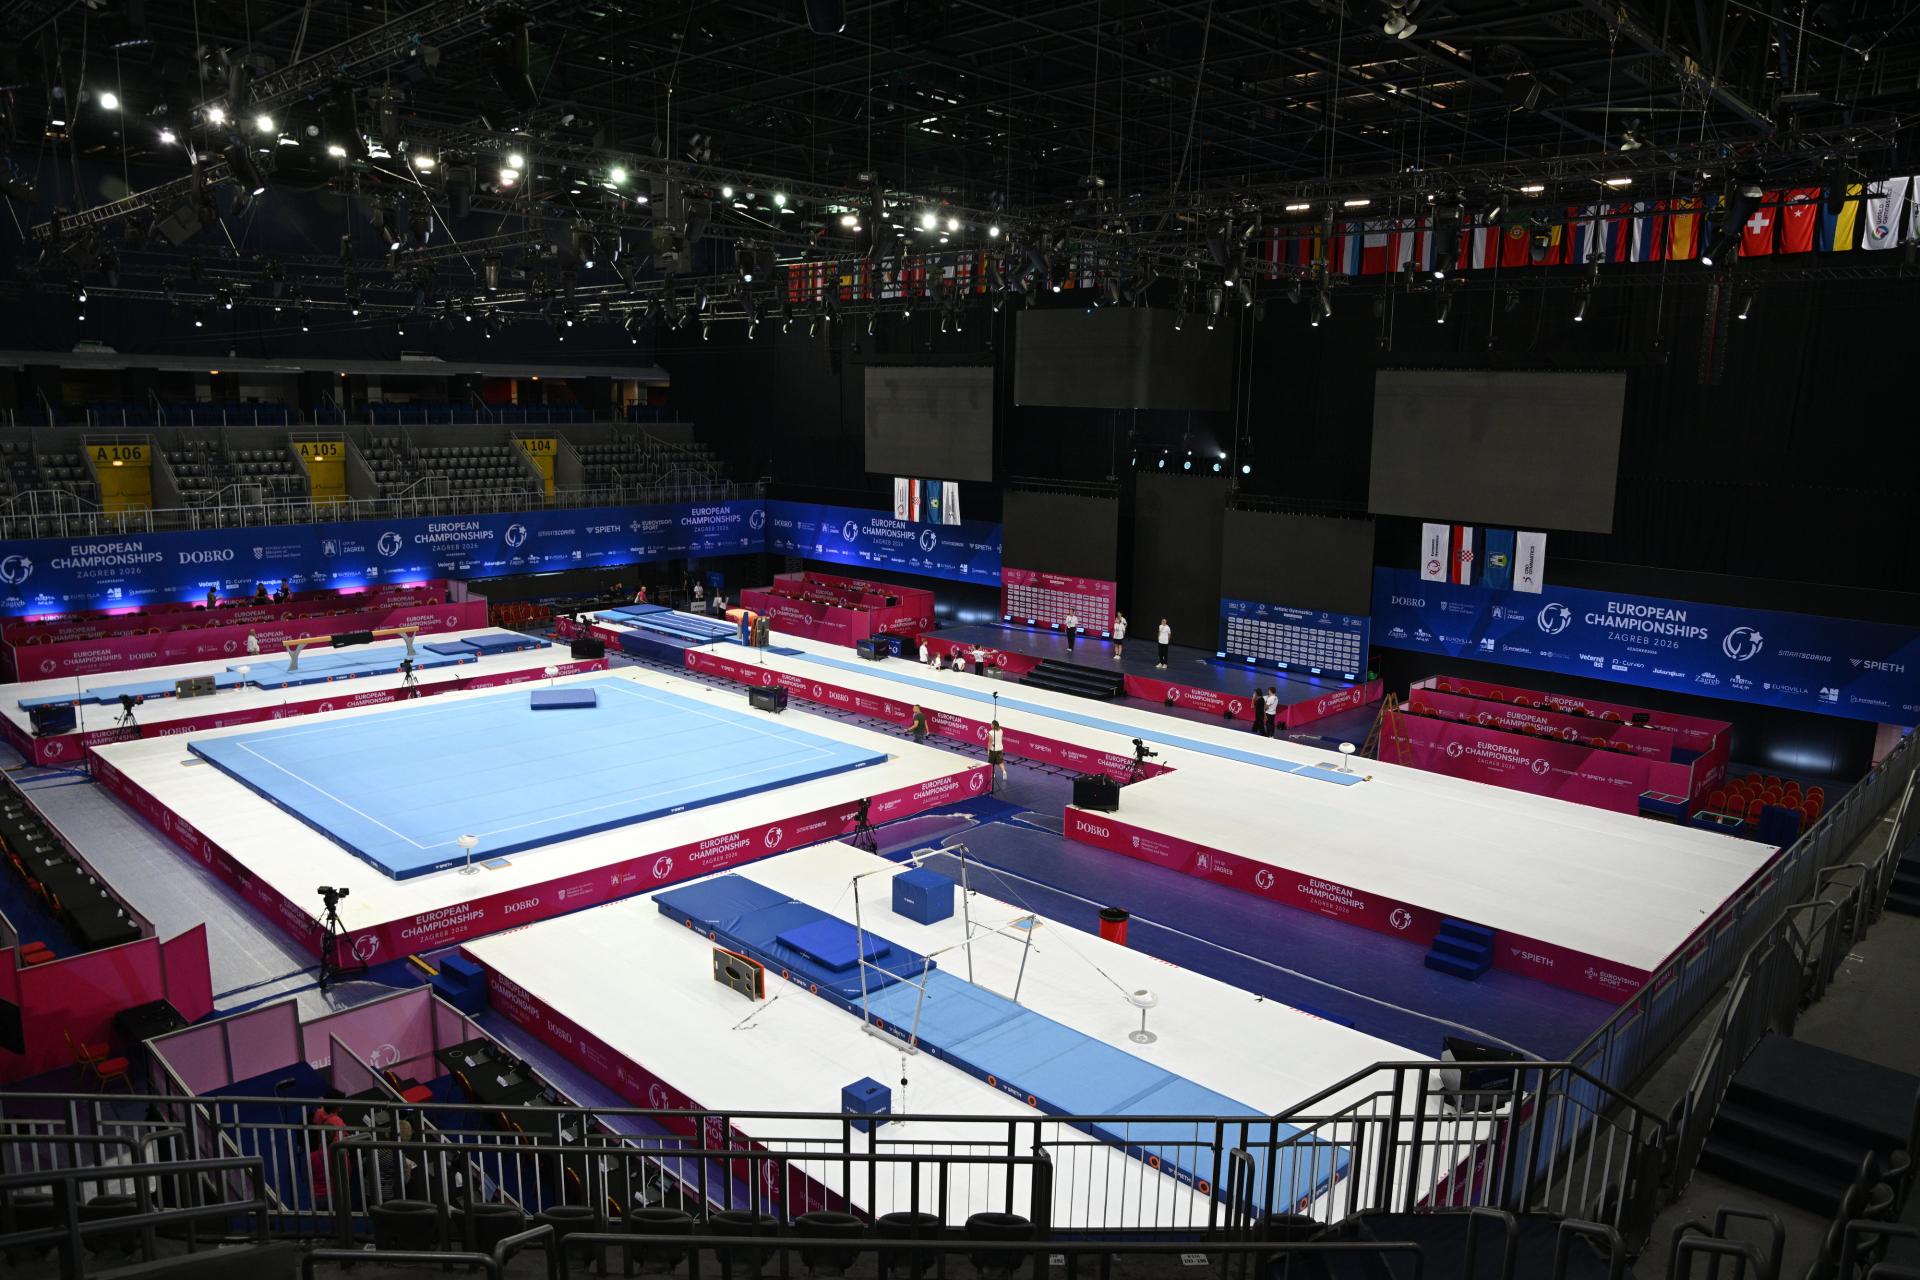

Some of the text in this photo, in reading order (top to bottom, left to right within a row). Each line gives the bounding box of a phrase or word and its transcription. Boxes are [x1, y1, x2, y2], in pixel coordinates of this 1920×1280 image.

[301, 444, 336, 456] A 105
[531, 441, 550, 451] 104
[97, 447, 141, 460] A 106
[691, 507, 730, 516] EUROPEAN
[429, 522, 479, 532] EUROPEAN
[681, 515, 741, 526] CHAMPIONSHIPS
[871, 519, 905, 529] EUROPEAN
[415, 530, 494, 544] CHAMPIONSHIPS
[595, 526, 620, 534] SPIETH
[862, 527, 915, 540] CHAMPIONSHIPS
[71, 542, 142, 556] EUROPEAN
[51, 552, 163, 569] CHAMPIONSHIPS
[179, 549, 234, 564] DOBRO
[119, 567, 141, 576] 2026
[1392, 596, 1425, 607] DOBRO
[1608, 602, 1687, 623] EUROPEAN
[1585, 613, 1708, 641] CHAMPIONSHIPS
[1608, 632, 1679, 650] ZAGREB 2026
[1778, 649, 1831, 663] SMARTSCORING
[1864, 660, 1904, 673] SPIETH
[1695, 674, 1720, 685] Zagreb
[1191, 689, 1217, 698] EUROPEAN
[1772, 684, 1808, 694] EUROVILLA
[355, 692, 386, 701] EUROPEAN
[829, 691, 849, 702] DOBRO
[1185, 693, 1223, 706] CHAMPIONSHIPS
[1544, 695, 1584, 707] EUROPEAN
[932, 717, 968, 731] CHAMPIONSHIPS
[938, 712, 962, 723] EUROPEAN
[1507, 712, 1547, 724] EUROPEAN
[1477, 741, 1519, 755] EUROPEAN
[1465, 747, 1529, 766] CHAMPIONSHIPS
[913, 782, 959, 800] CHAMPIONSHIPS
[921, 777, 951, 791] EUROPEAN
[1076, 820, 1110, 838] DOBRO
[700, 833, 739, 850] EUROPEAN
[689, 839, 750, 861] CHAMPIONSHIPS
[702, 855, 724, 866] ZAGREB
[1213, 864, 1233, 876] ZAGREB
[1309, 879, 1353, 897] EUROPEAN
[1298, 884, 1365, 910] CHAMPIONSHIPS
[504, 898, 539, 914] DOBRO
[416, 904, 469, 924] EUROPEAN
[401, 909, 484, 939] CHAMPIONSHIPS
[420, 925, 468, 943] ZAGREB 2026
[1521, 951, 1554, 967] SPIETH
[1599, 976, 1621, 986] SPORT
[1600, 971, 1640, 987] EUROVISION
[499, 974, 530, 1001] EUROPEAN
[491, 979, 540, 1019] CHAMPIONSHIPS
[547, 1020, 572, 1044] DOBRO
